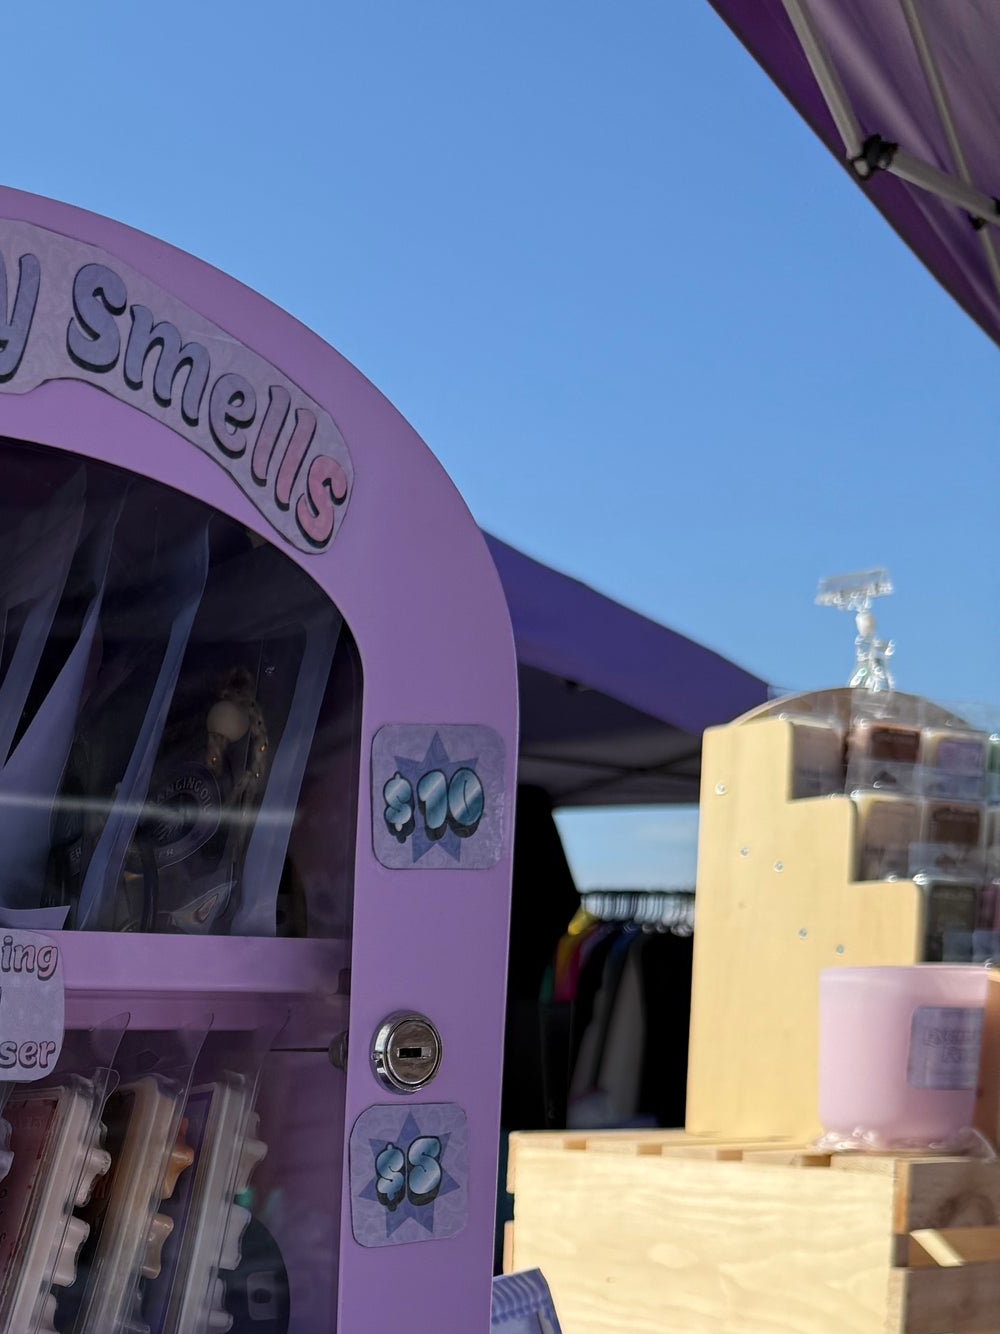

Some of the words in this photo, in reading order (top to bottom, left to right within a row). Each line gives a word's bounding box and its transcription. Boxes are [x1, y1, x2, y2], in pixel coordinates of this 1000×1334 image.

[68, 261, 348, 549] Smells
[382, 768, 486, 844] $10
[374, 1135, 442, 1211] $5
